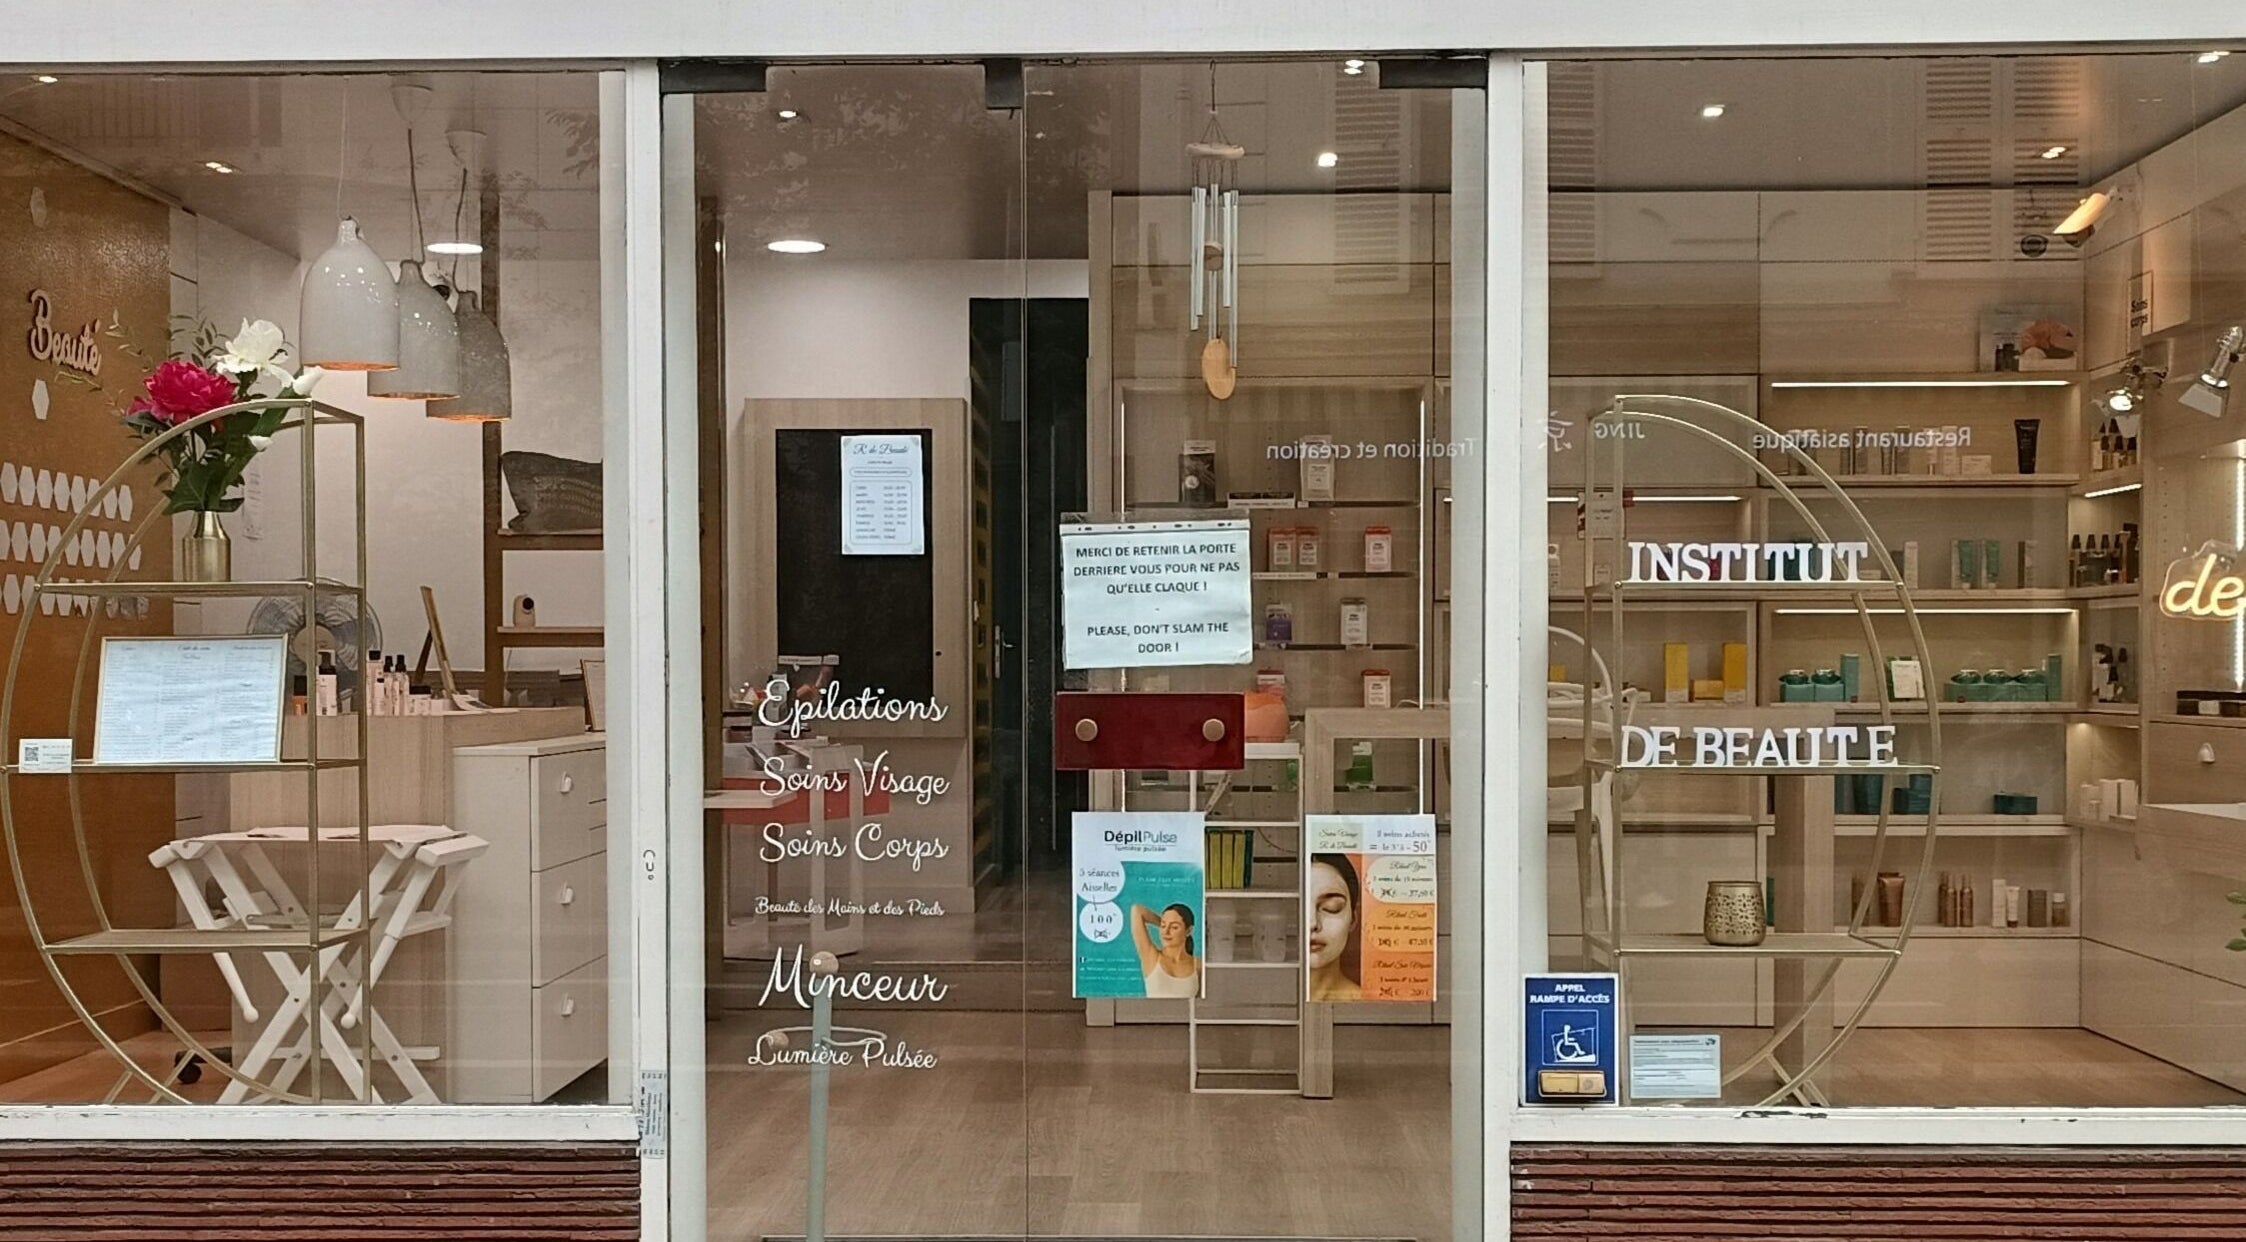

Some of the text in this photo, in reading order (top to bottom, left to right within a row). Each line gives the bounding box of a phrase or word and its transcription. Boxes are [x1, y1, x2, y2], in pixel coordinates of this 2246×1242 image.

[31, 289, 102, 377] Beauté
[1076, 543, 1237, 558] MERCI DE RETENIR LA PORTE
[1628, 541, 1868, 582] INSTITUT
[1073, 561, 1240, 577] DERRIERE VOUS POUR NE PAS
[1106, 580, 1208, 595] QU'ELLE CLAQUE !
[1087, 622, 1229, 637] PLEASE, DON'T SLAM THE
[1138, 642, 1171, 653] DOOR
[757, 680, 949, 738] Epilations
[1620, 724, 1898, 768] DE BEAUTE
[760, 749, 950, 805] Soins Visage
[760, 822, 949, 871] Soins Corps
[804, 898, 825, 914] des
[827, 897, 866, 917] Mains
[868, 902, 882, 914] et
[883, 900, 904, 915] des
[906, 898, 945, 916] Pieds
[758, 943, 949, 1009] Minceur
[1555, 983, 1586, 993] APPEL
[1529, 992, 1610, 1004] RAMPE D'ACCÈS
[748, 1034, 938, 1069] Lumière Pulsée
